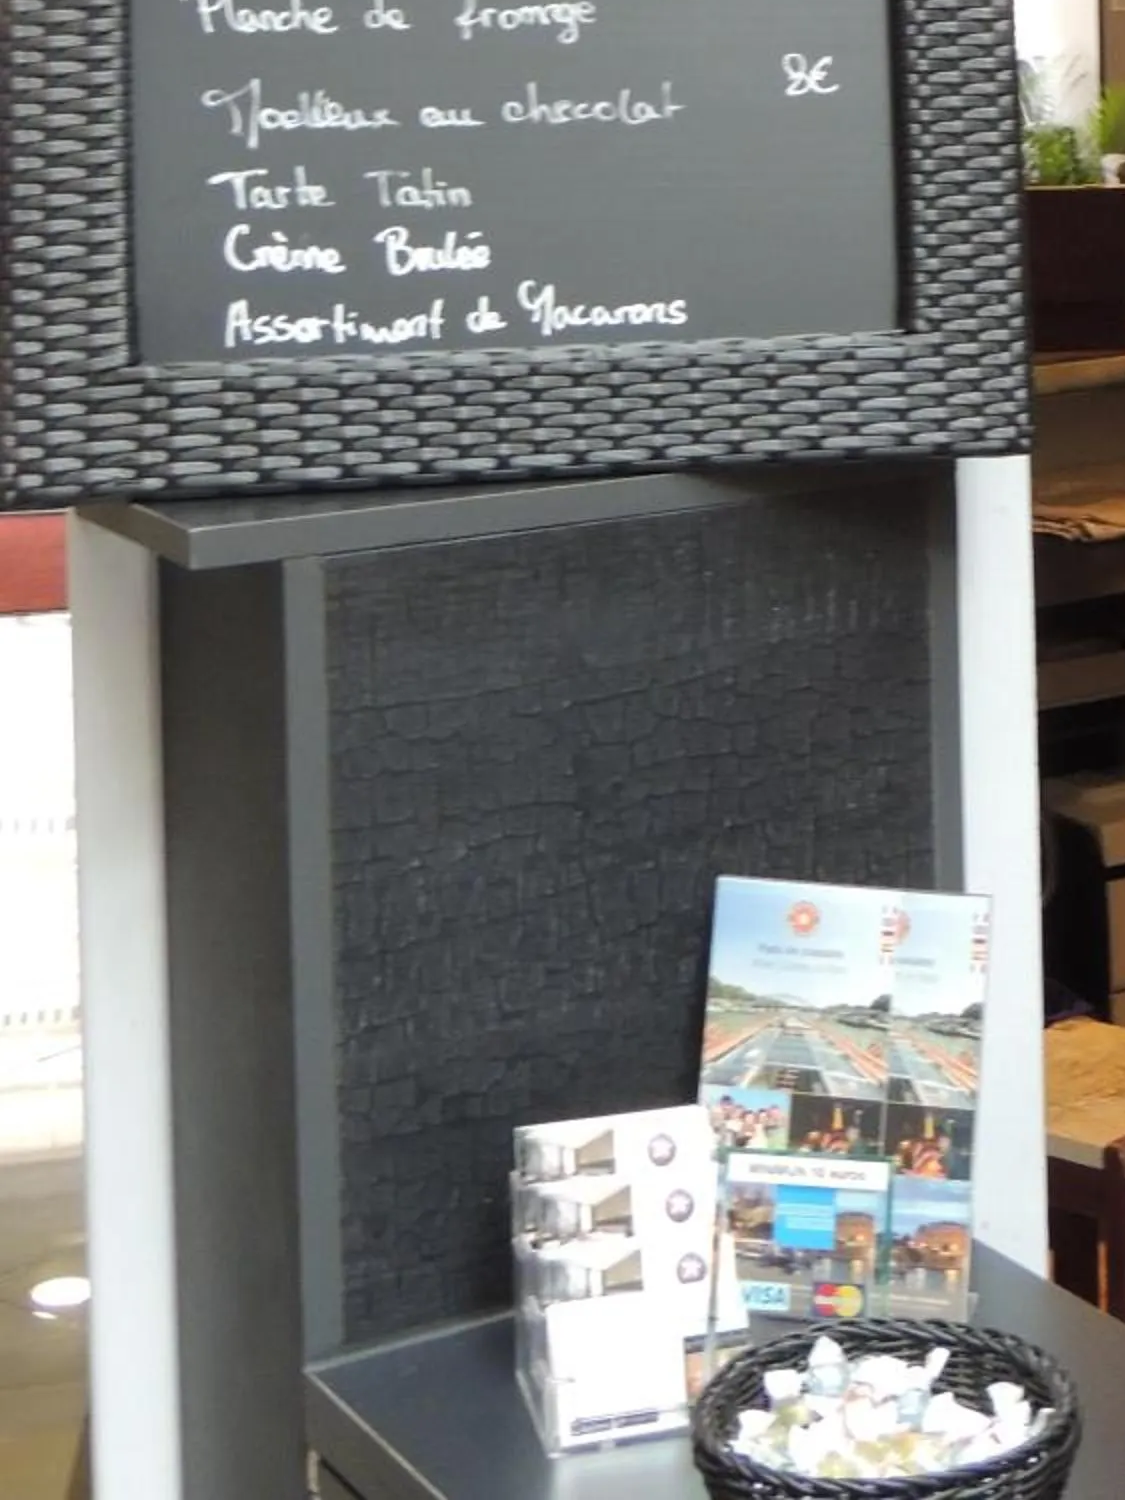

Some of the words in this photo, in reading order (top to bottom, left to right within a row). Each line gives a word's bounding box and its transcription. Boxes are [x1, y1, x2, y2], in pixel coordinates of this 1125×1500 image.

[781, 52, 840, 96] 8€
[419, 104, 485, 127] au
[207, 165, 335, 209] Tarte
[364, 166, 473, 210] Tatin
[223, 224, 347, 276] Crème
[465, 295, 508, 335] de
[517, 278, 690, 337] Macarons
[743, 1286, 786, 1303] VISA
